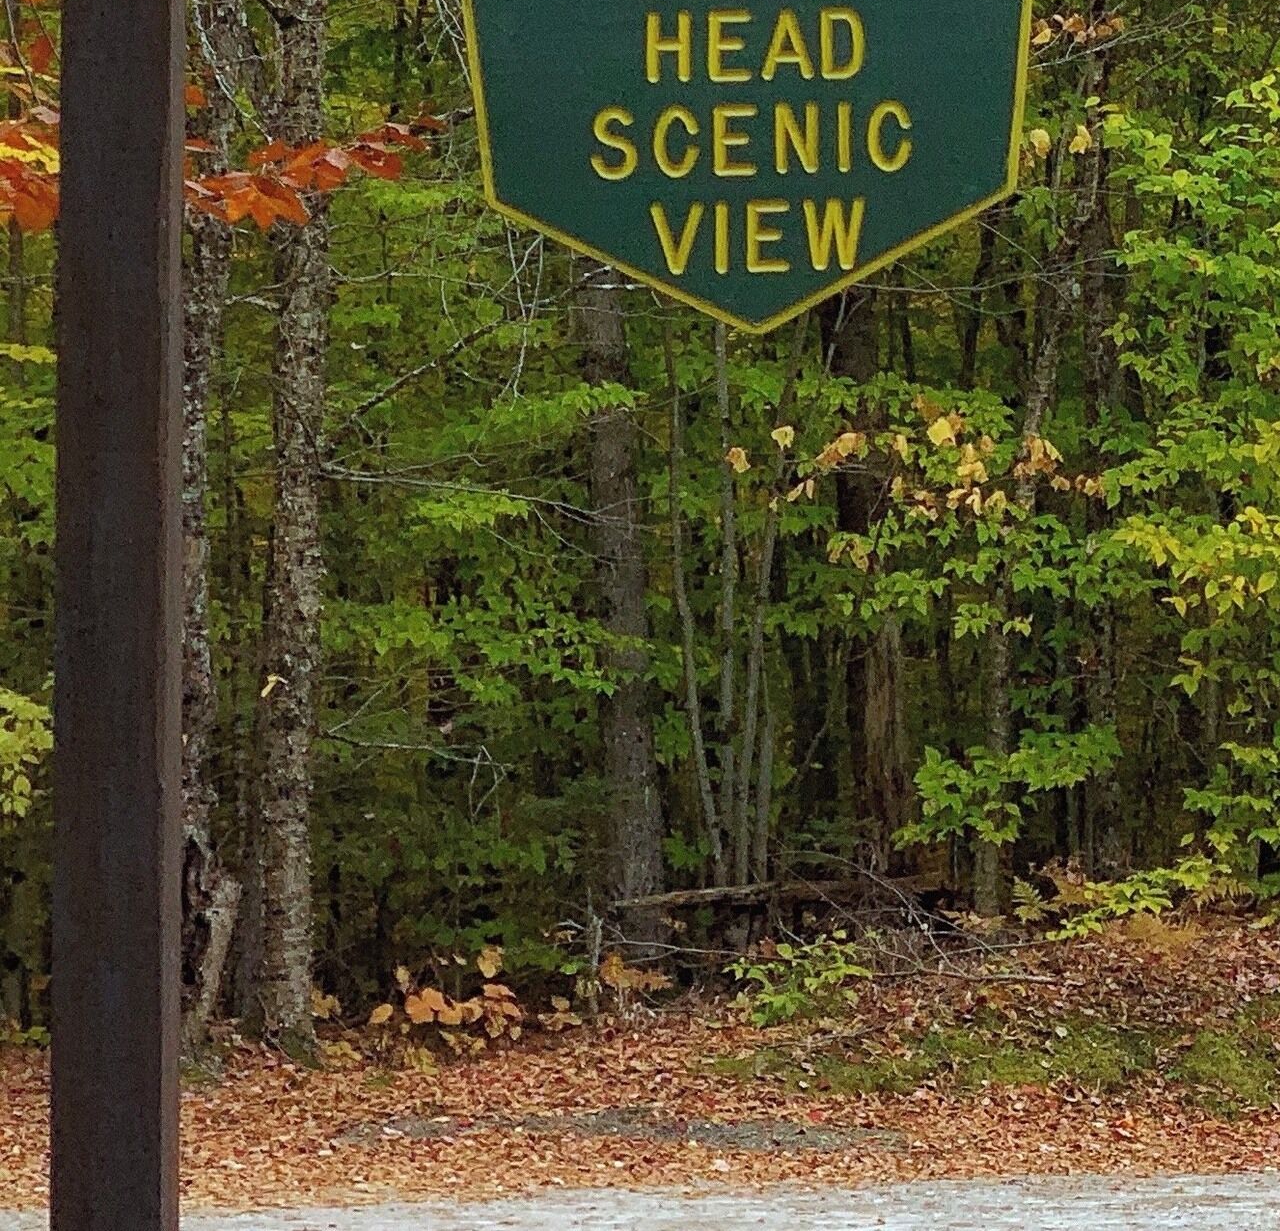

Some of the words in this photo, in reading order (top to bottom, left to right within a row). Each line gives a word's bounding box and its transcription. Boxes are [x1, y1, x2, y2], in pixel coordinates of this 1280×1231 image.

[645, 6, 866, 83] HEAD
[590, 100, 913, 180] SCENIC
[650, 197, 866, 276] VIEW
